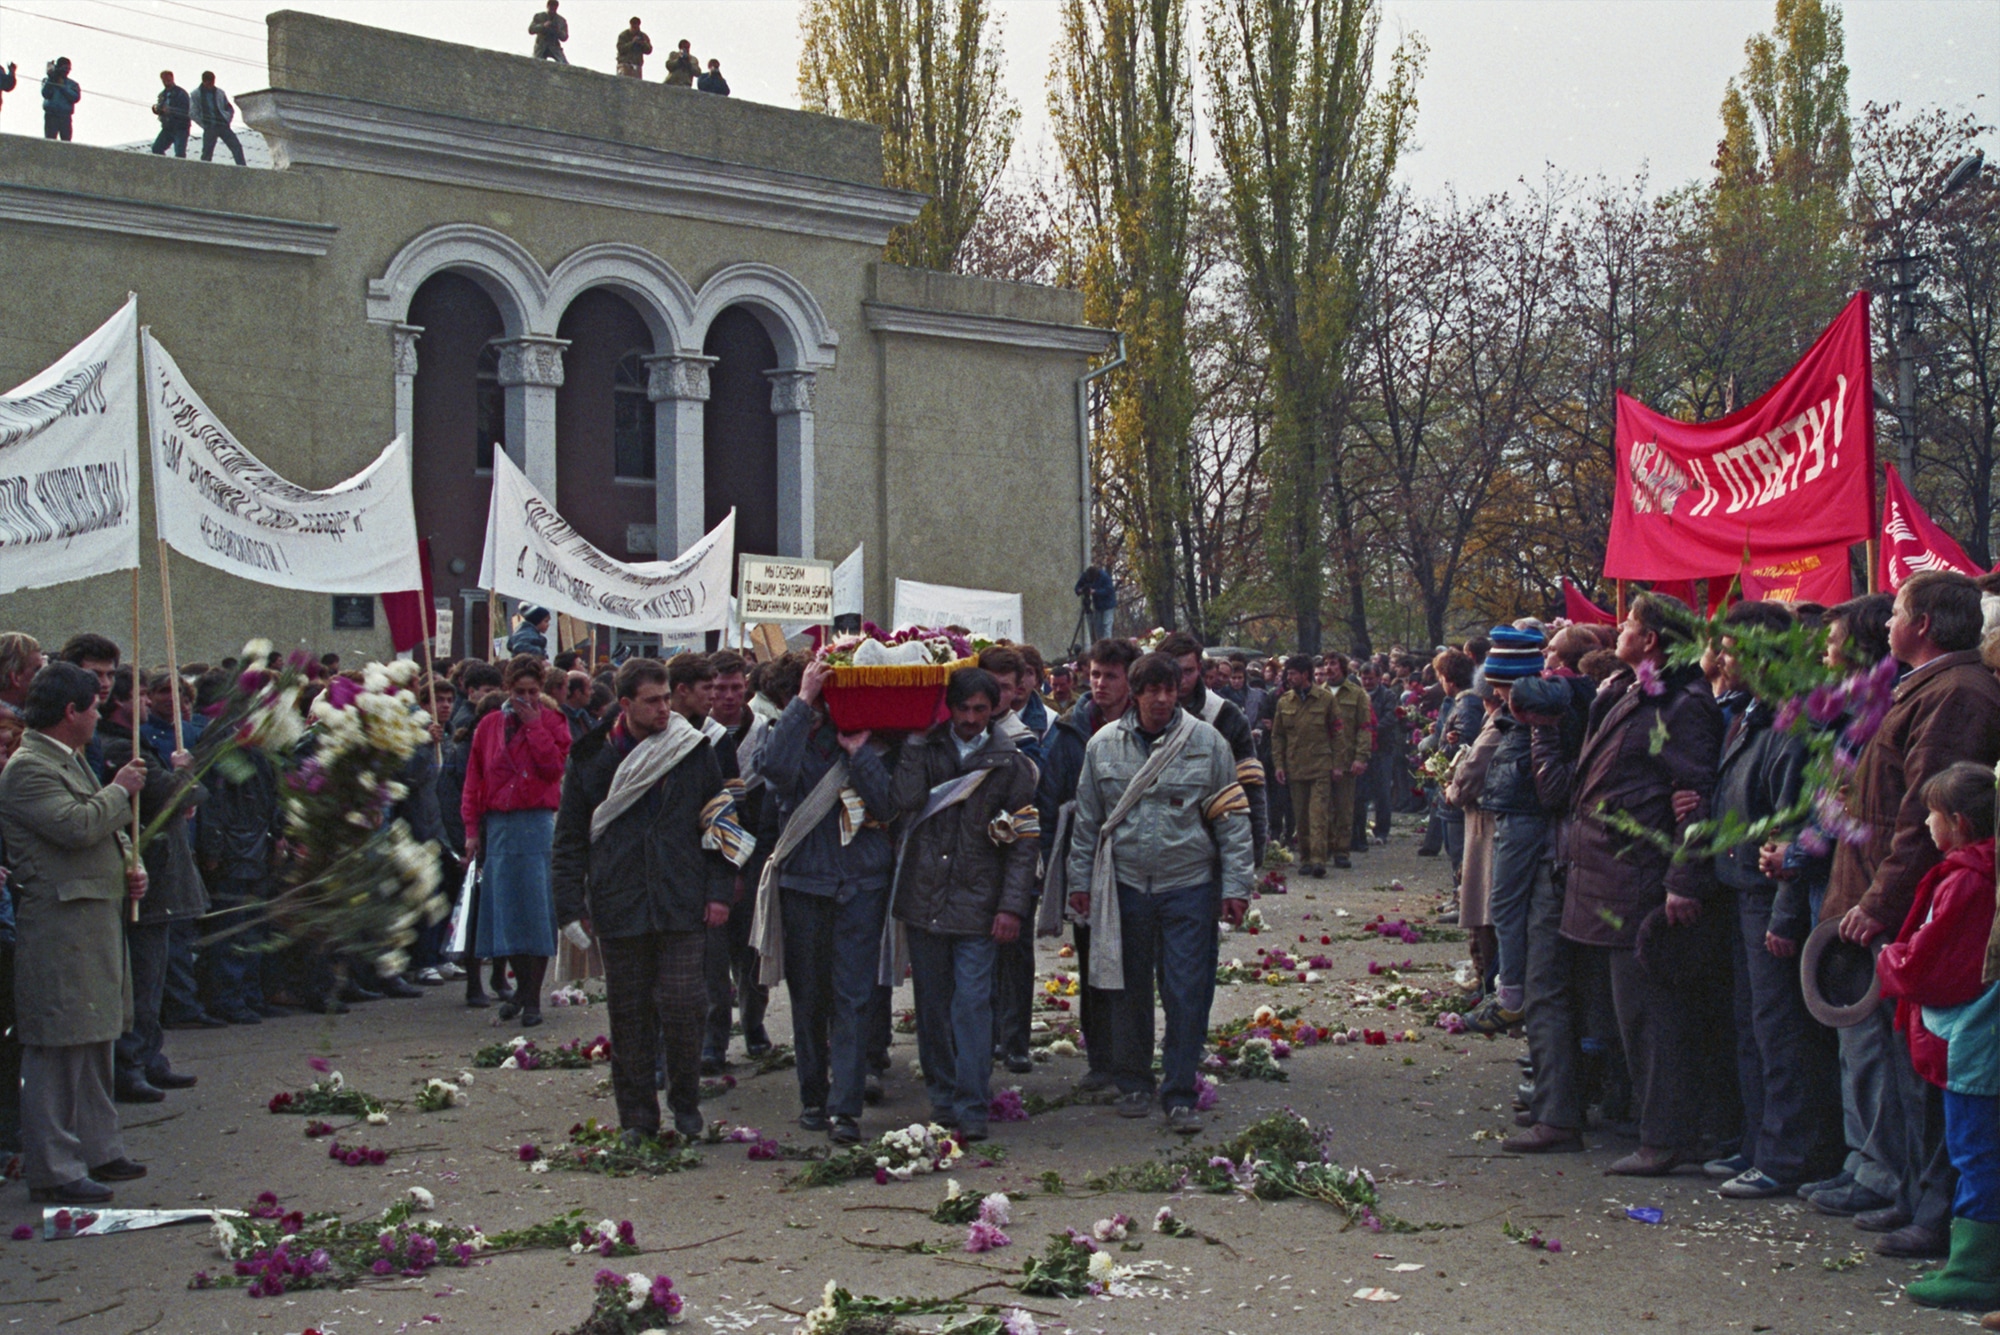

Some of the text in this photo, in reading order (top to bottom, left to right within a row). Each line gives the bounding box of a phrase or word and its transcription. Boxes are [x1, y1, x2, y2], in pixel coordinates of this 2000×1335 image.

[1687, 458, 1719, 517] К
[1712, 374, 1847, 516] ОТВЕТУ!
[525, 497, 579, 546] КОСТАШ
[516, 545, 528, 579] А
[764, 565, 806, 580] МЫ СКОРБИМ
[744, 580, 753, 594] ПО
[753, 582, 777, 596] НАШИМ
[811, 584, 833, 599] УБИТЫМ
[746, 599, 791, 614] ВООРУЖЕННЫМИ
